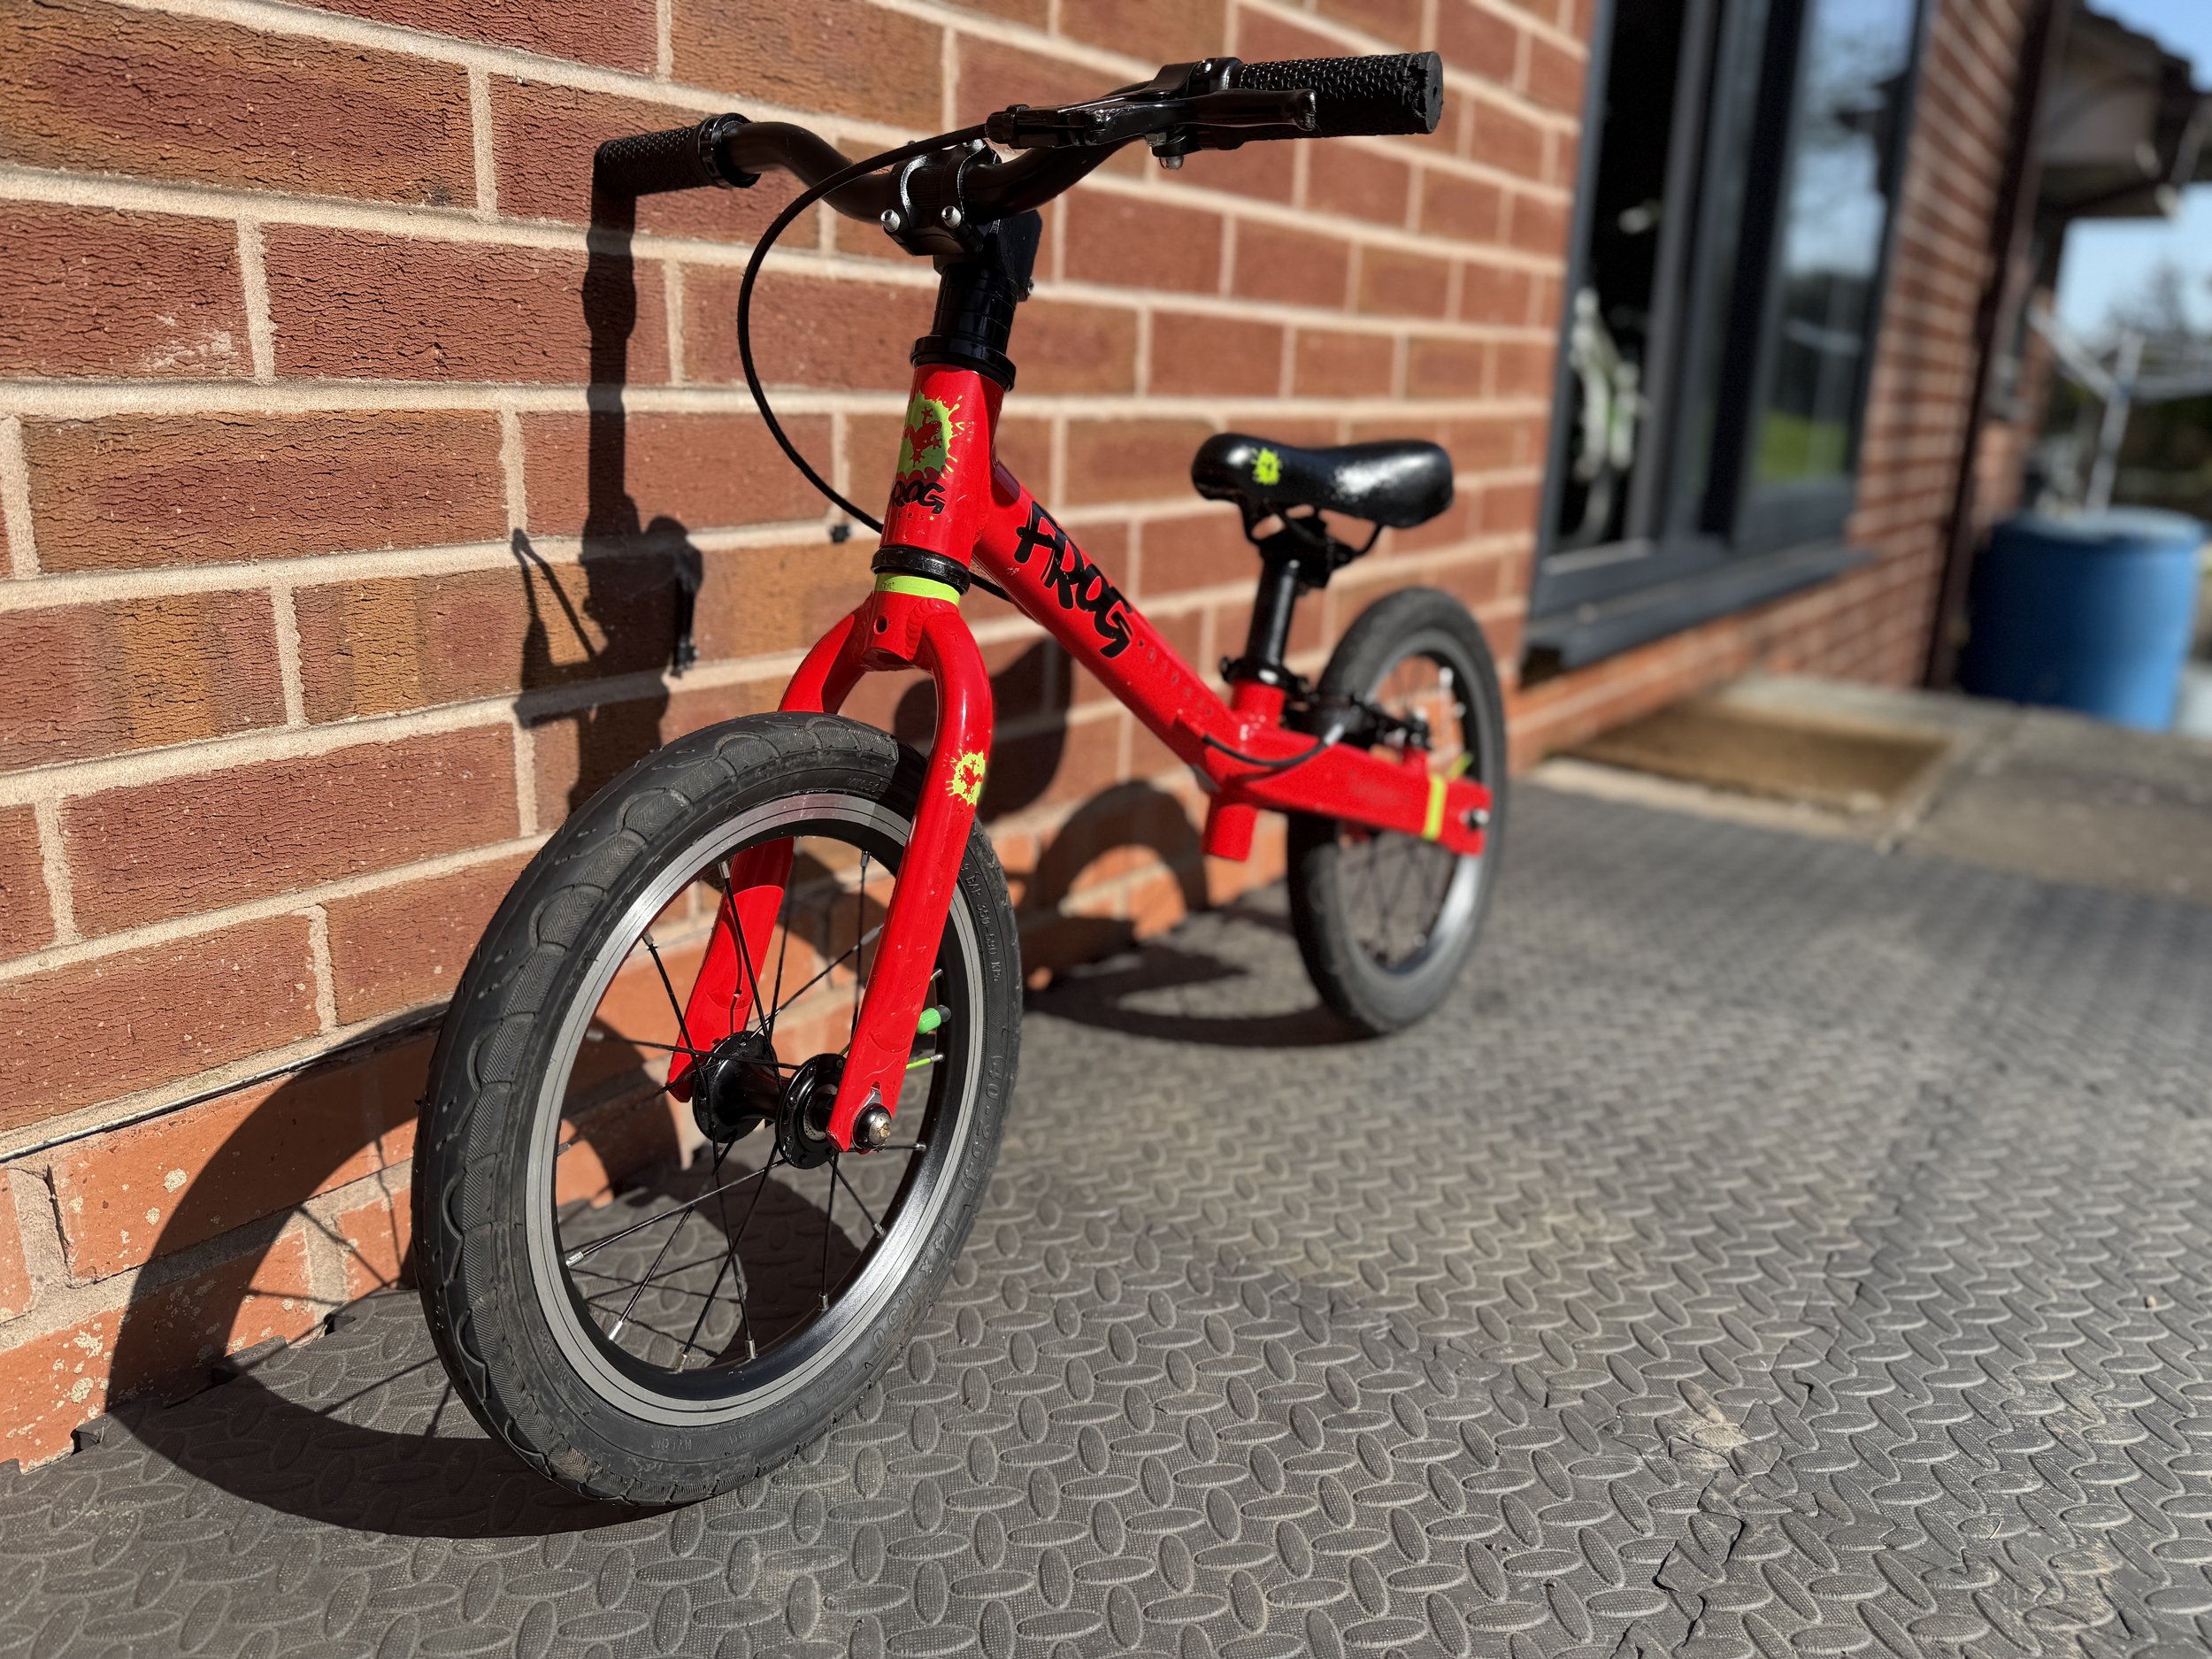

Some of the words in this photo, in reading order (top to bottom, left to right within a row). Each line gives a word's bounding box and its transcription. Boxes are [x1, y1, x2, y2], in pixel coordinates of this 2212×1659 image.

[891, 480, 946, 514] ROG
[1013, 500, 1133, 658] FROG
[872, 1286, 918, 1349] 1.50
